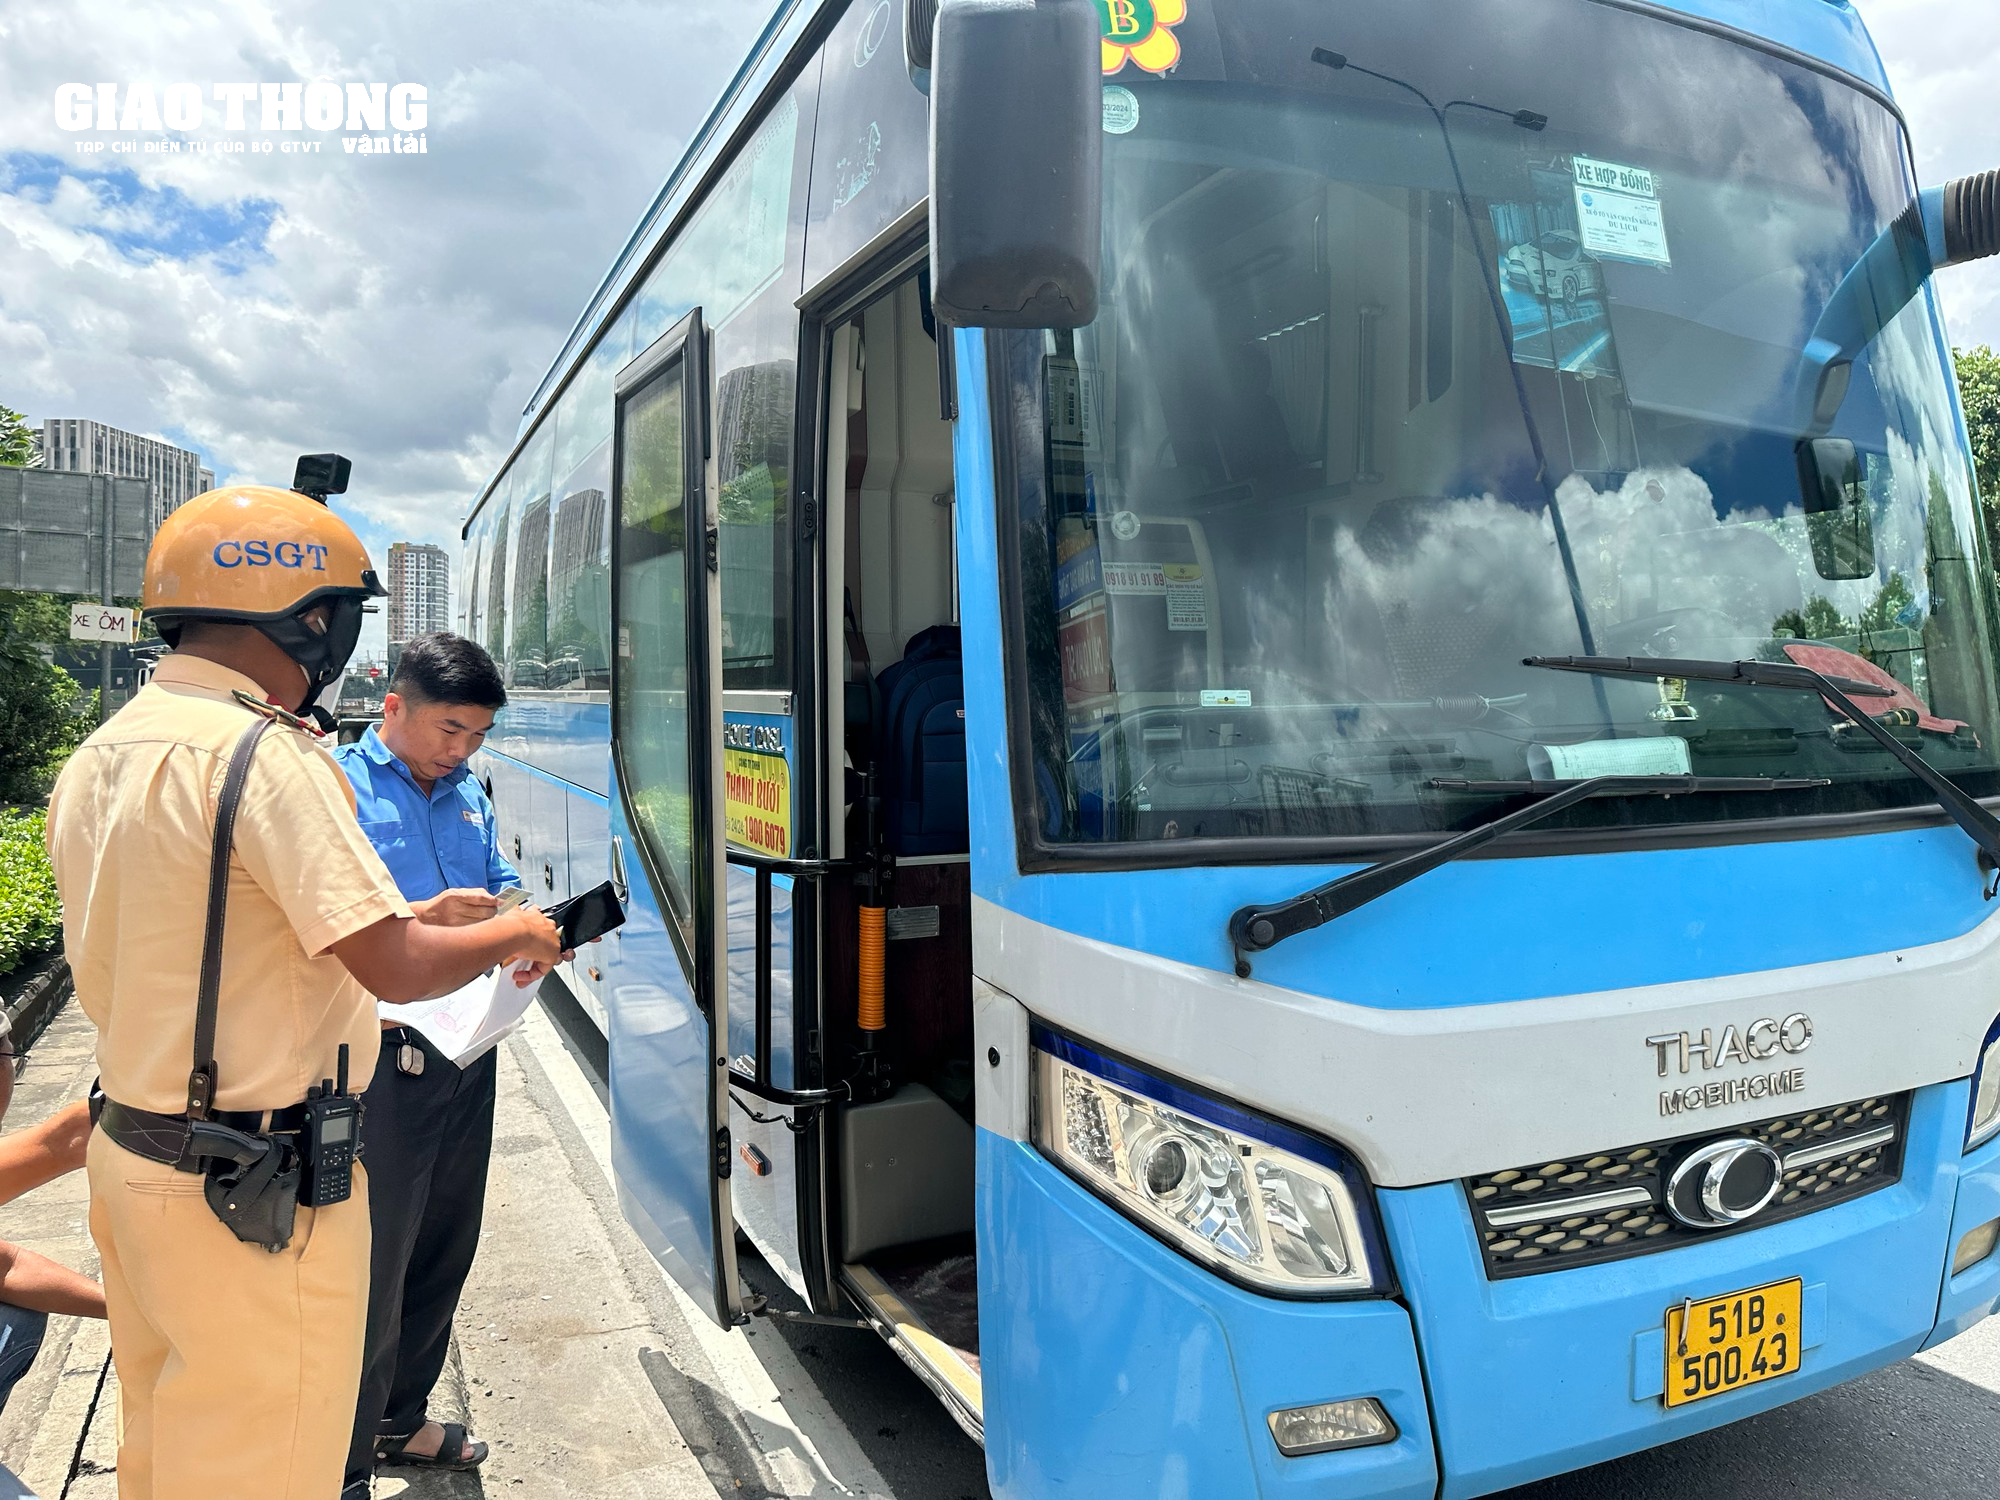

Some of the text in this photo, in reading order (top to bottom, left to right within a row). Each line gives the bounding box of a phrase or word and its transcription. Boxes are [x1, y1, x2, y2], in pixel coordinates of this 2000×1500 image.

[1576, 162, 1651, 193] XE HỢP ĐỒNG
[1608, 221, 1638, 232] DU LỊCH
[213, 540, 328, 571] CSGT
[1105, 572, 1127, 586] 0918
[1129, 572, 1139, 586] 91
[1141, 572, 1151, 586] 91
[1152, 572, 1165, 586] 89
[73, 611, 125, 632] XE ÔM
[757, 773, 780, 814] BƯỞI
[745, 815, 763, 846] 1900
[765, 821, 786, 855] 6079
[1646, 1012, 1814, 1077] THACO
[1659, 1067, 1806, 1116] MOBIHOME
[1708, 1294, 1765, 1345] 51B
[1683, 1332, 1787, 1397] 500.43
